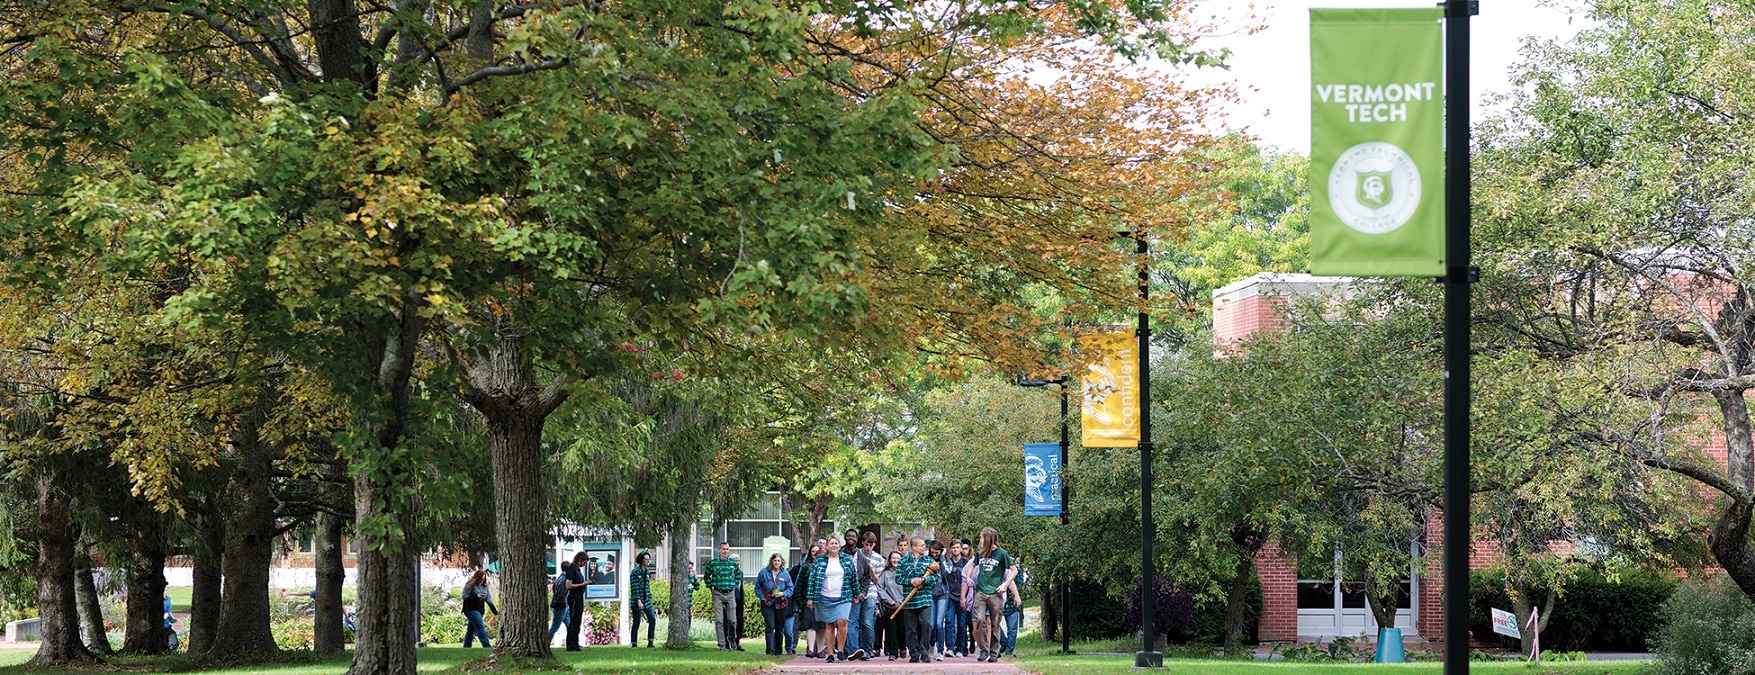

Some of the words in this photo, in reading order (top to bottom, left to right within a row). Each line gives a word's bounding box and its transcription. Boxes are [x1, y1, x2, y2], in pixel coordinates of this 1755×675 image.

[1316, 82, 1435, 103] VERMONT
[1344, 103, 1407, 123] TECH
[1117, 346, 1134, 427] confident
[1493, 617, 1508, 627] FREE
